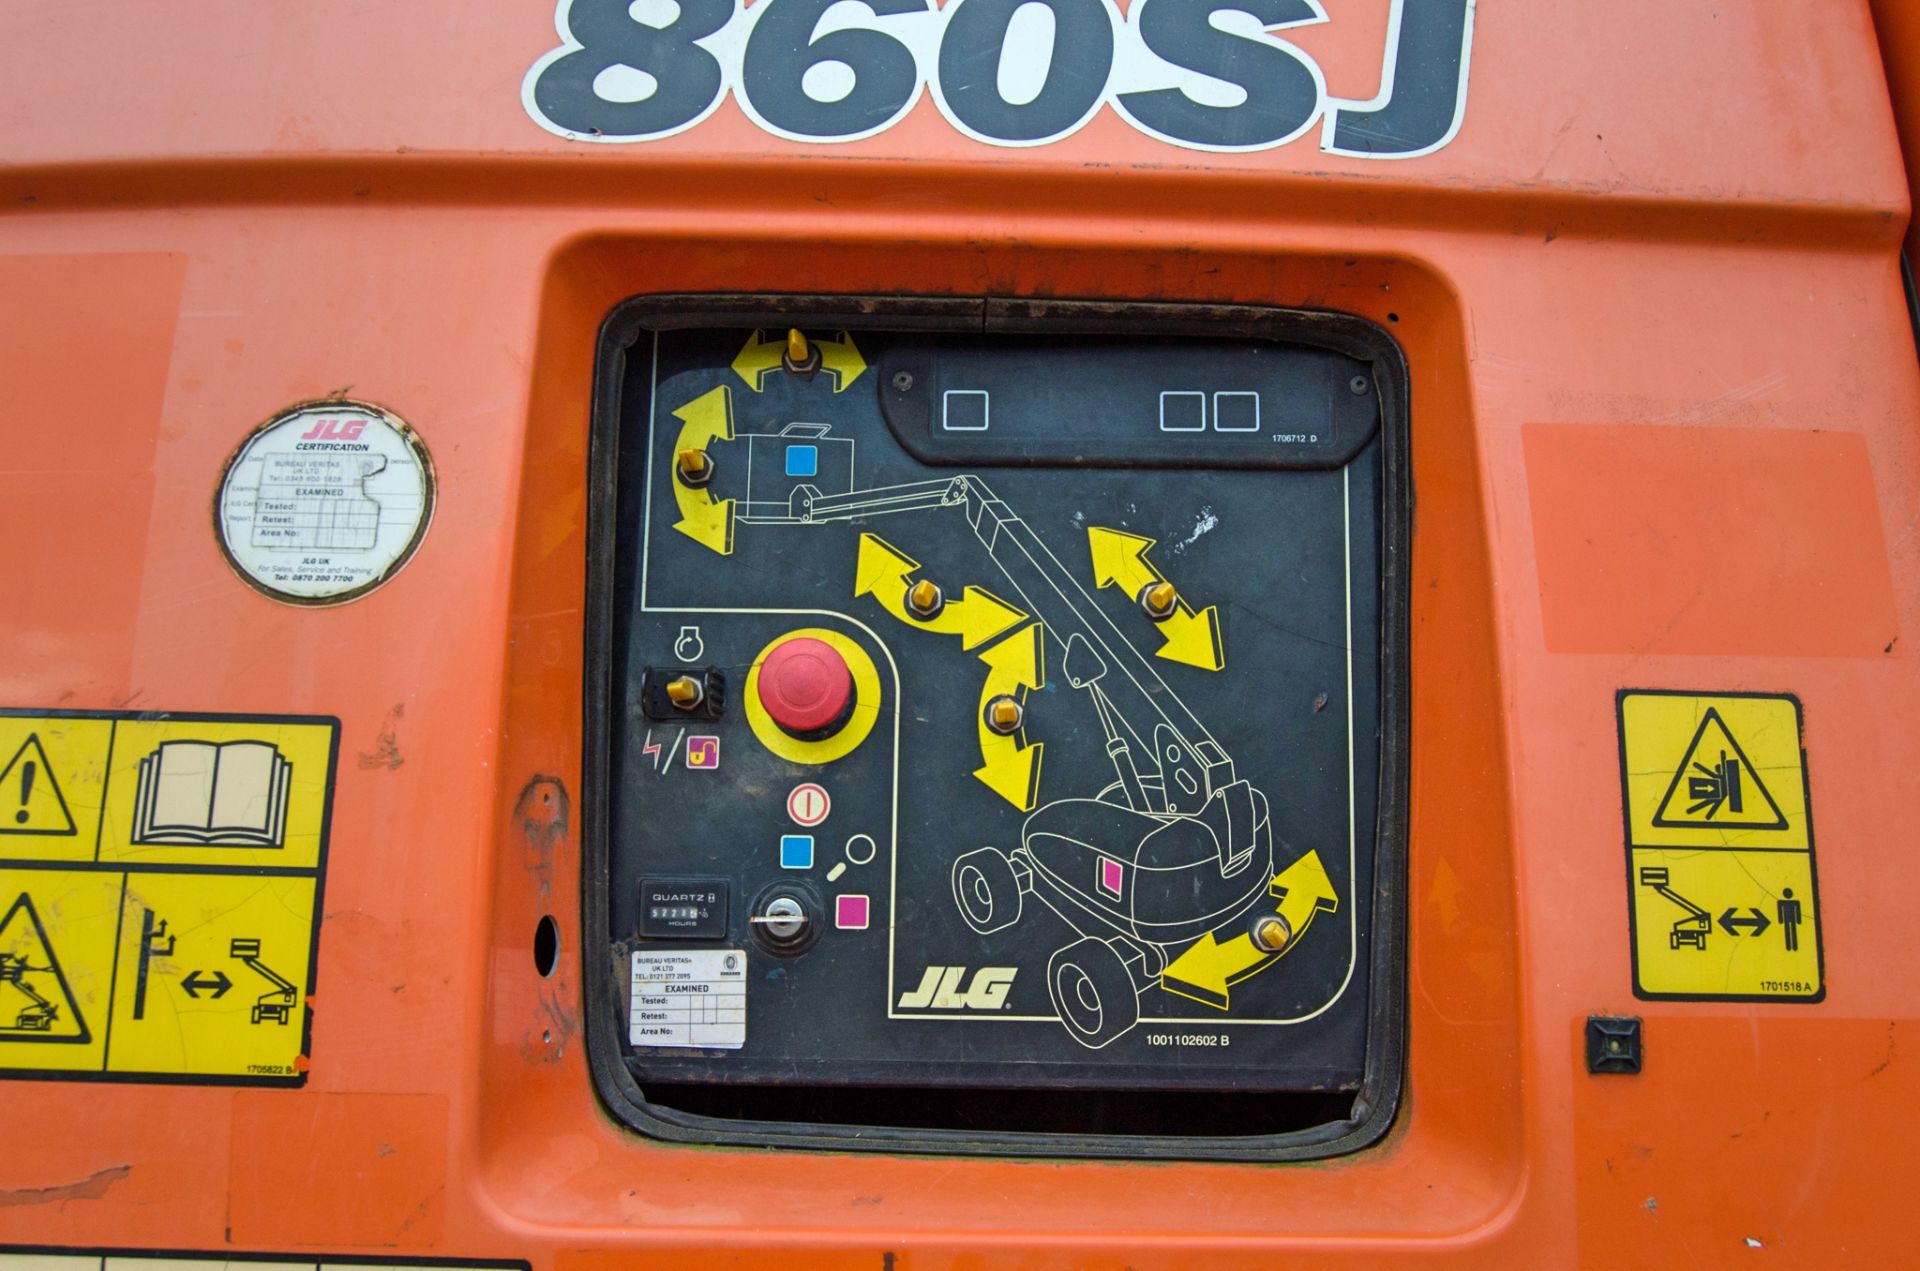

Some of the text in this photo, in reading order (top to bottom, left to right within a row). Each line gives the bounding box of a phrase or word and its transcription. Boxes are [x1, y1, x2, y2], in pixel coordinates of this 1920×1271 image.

[523, 0, 1475, 158] 860SJ
[302, 420, 368, 440] JLG
[1272, 434, 1317, 443] 1706712 D
[296, 443, 369, 451] CERTIFICATION
[274, 460, 307, 468] BUREAU
[295, 488, 345, 496] EXAMINED
[264, 502, 297, 510] Tested:
[327, 566, 342, 574] and
[343, 567, 373, 576] Training
[652, 893, 705, 902] QUARTZ
[665, 985, 709, 993] EXAMINED
[897, 965, 1019, 1010] JLG
[1760, 981, 1812, 992] 1701518 A
[641, 997, 668, 1005] Tested:
[641, 1012, 668, 1020] Retest:
[1146, 1034, 1230, 1047] 1001102602 B
